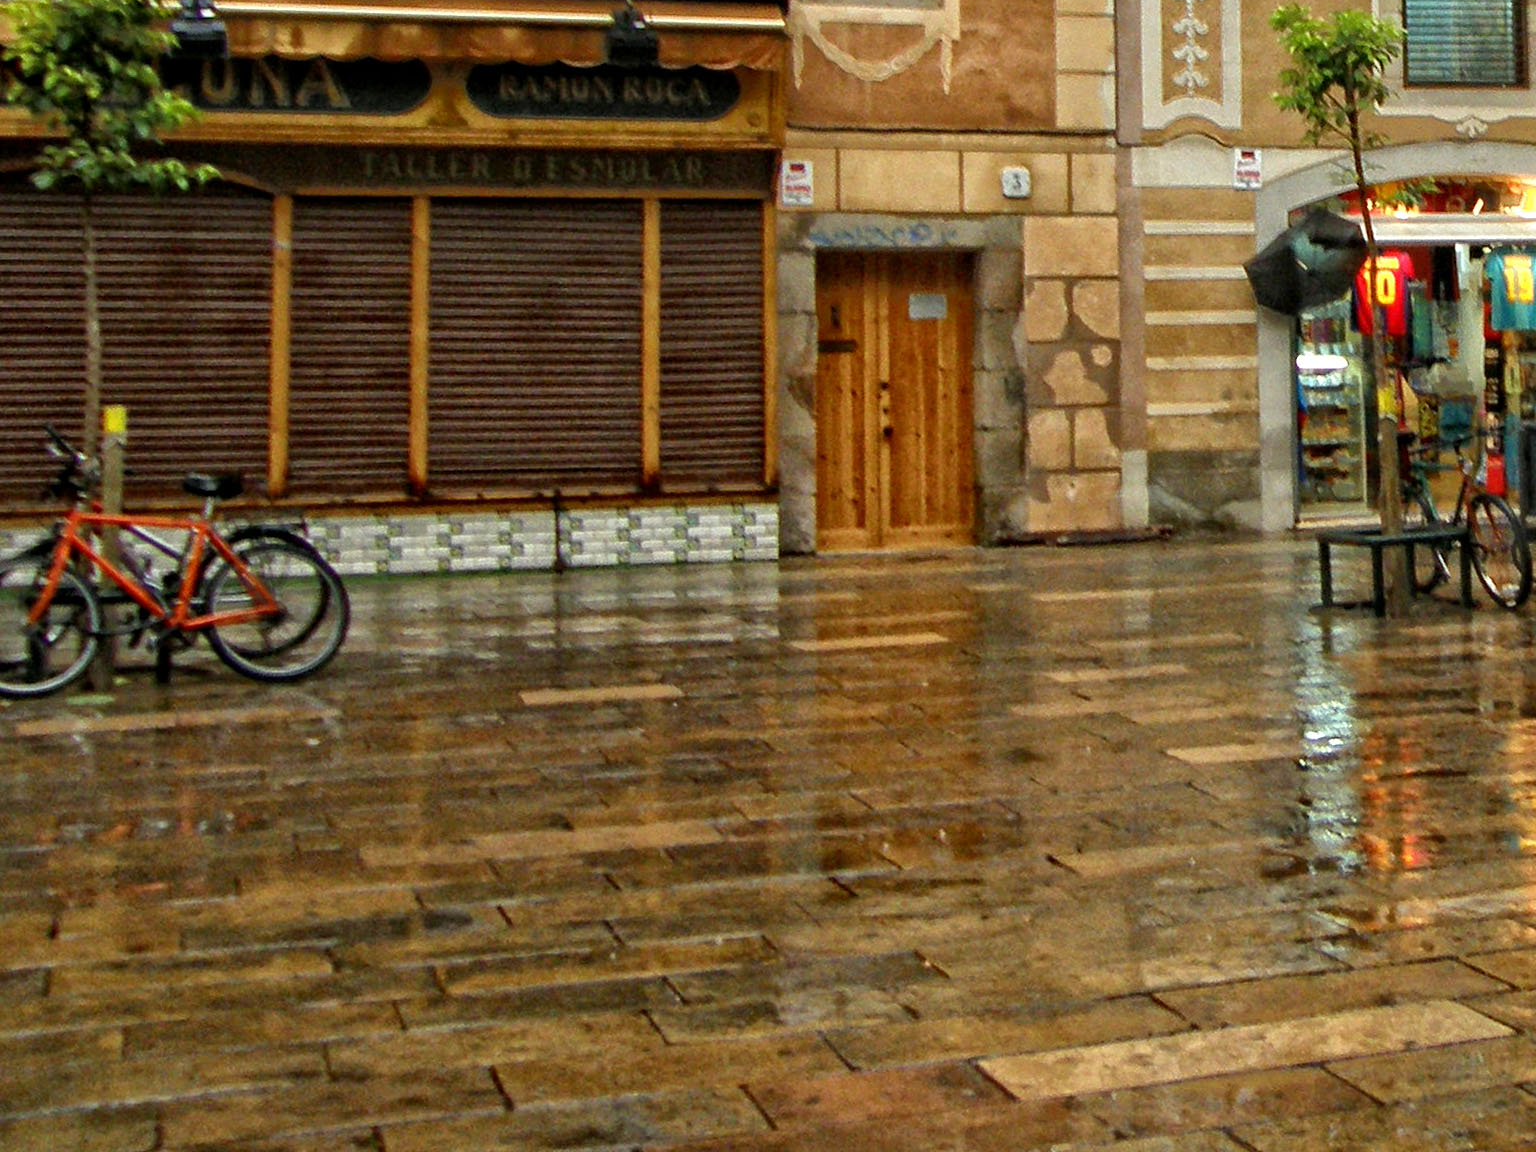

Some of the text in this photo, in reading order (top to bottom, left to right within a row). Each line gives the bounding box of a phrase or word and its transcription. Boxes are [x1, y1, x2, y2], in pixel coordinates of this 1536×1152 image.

[172, 58, 351, 108] UNA
[500, 74, 711, 105] RAMON ROCA
[366, 152, 701, 183] TALLER DESMOLAR
[1363, 270, 1396, 305] 10
